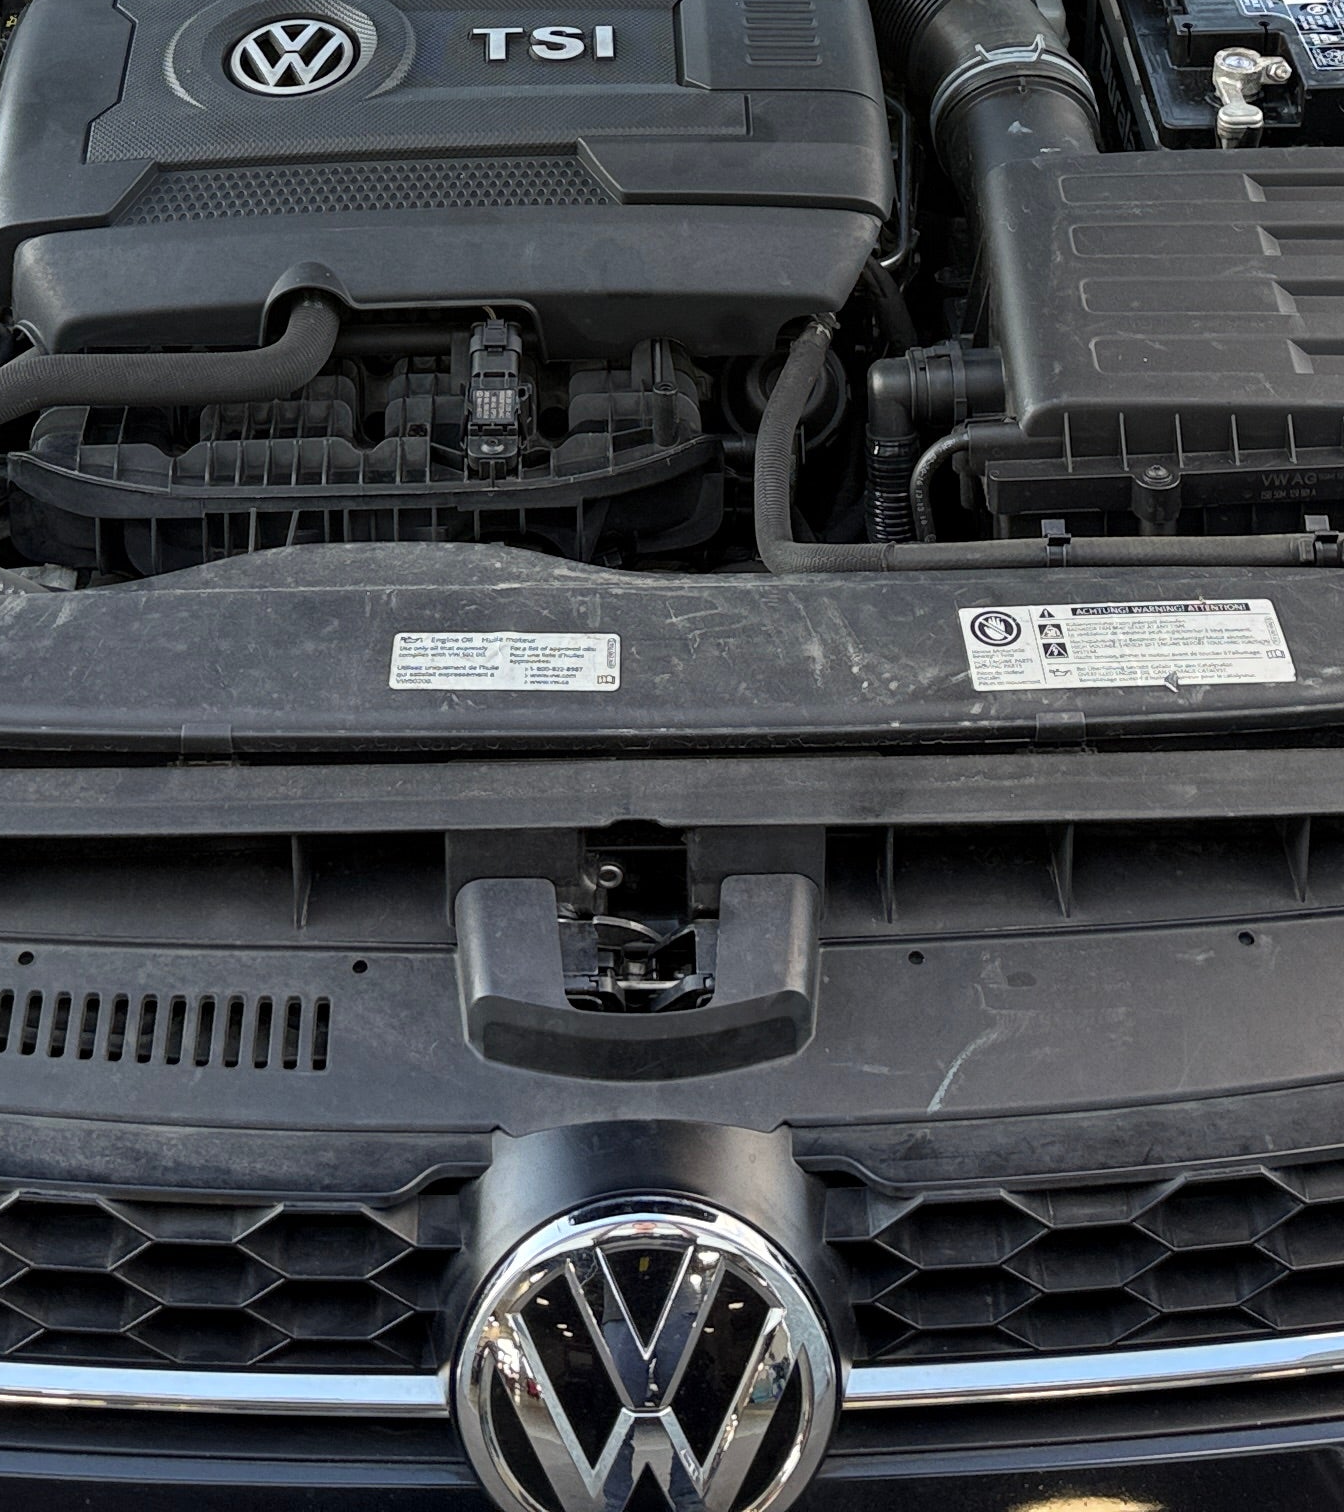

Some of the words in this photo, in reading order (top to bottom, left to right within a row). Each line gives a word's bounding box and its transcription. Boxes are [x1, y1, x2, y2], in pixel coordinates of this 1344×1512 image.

[469, 24, 616, 63] TSI
[1075, 606, 1130, 616] ACHTUNG!
[1131, 604, 1185, 614] WARNING!
[1187, 603, 1248, 612] ATTENTION!
[430, 636, 460, 645] Engine
